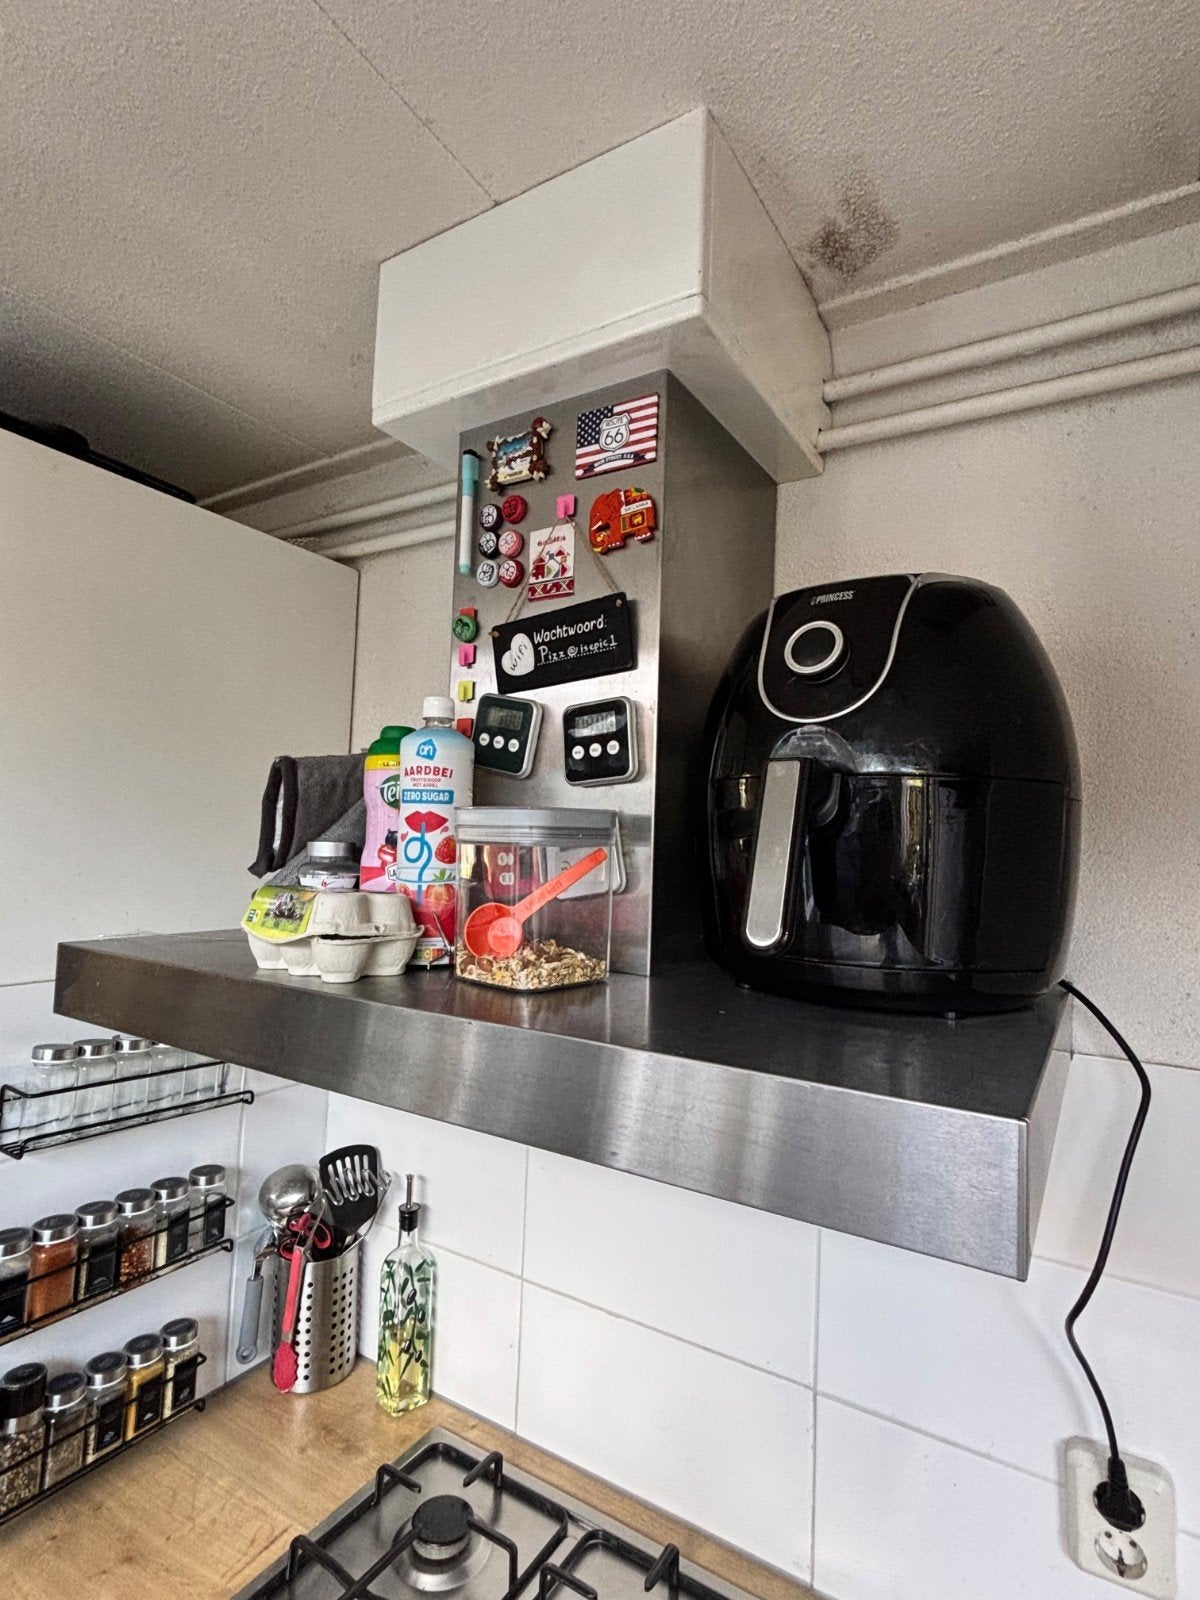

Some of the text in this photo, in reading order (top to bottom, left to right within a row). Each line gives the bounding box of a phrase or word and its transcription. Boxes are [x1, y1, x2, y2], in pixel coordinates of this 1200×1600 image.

[605, 418, 624, 427] ROUTE
[604, 428, 624, 446] 66
[815, 590, 854, 604] PRINCESS
[404, 765, 454, 779] AARDBEI
[403, 791, 450, 802] ZERO SUGAR
